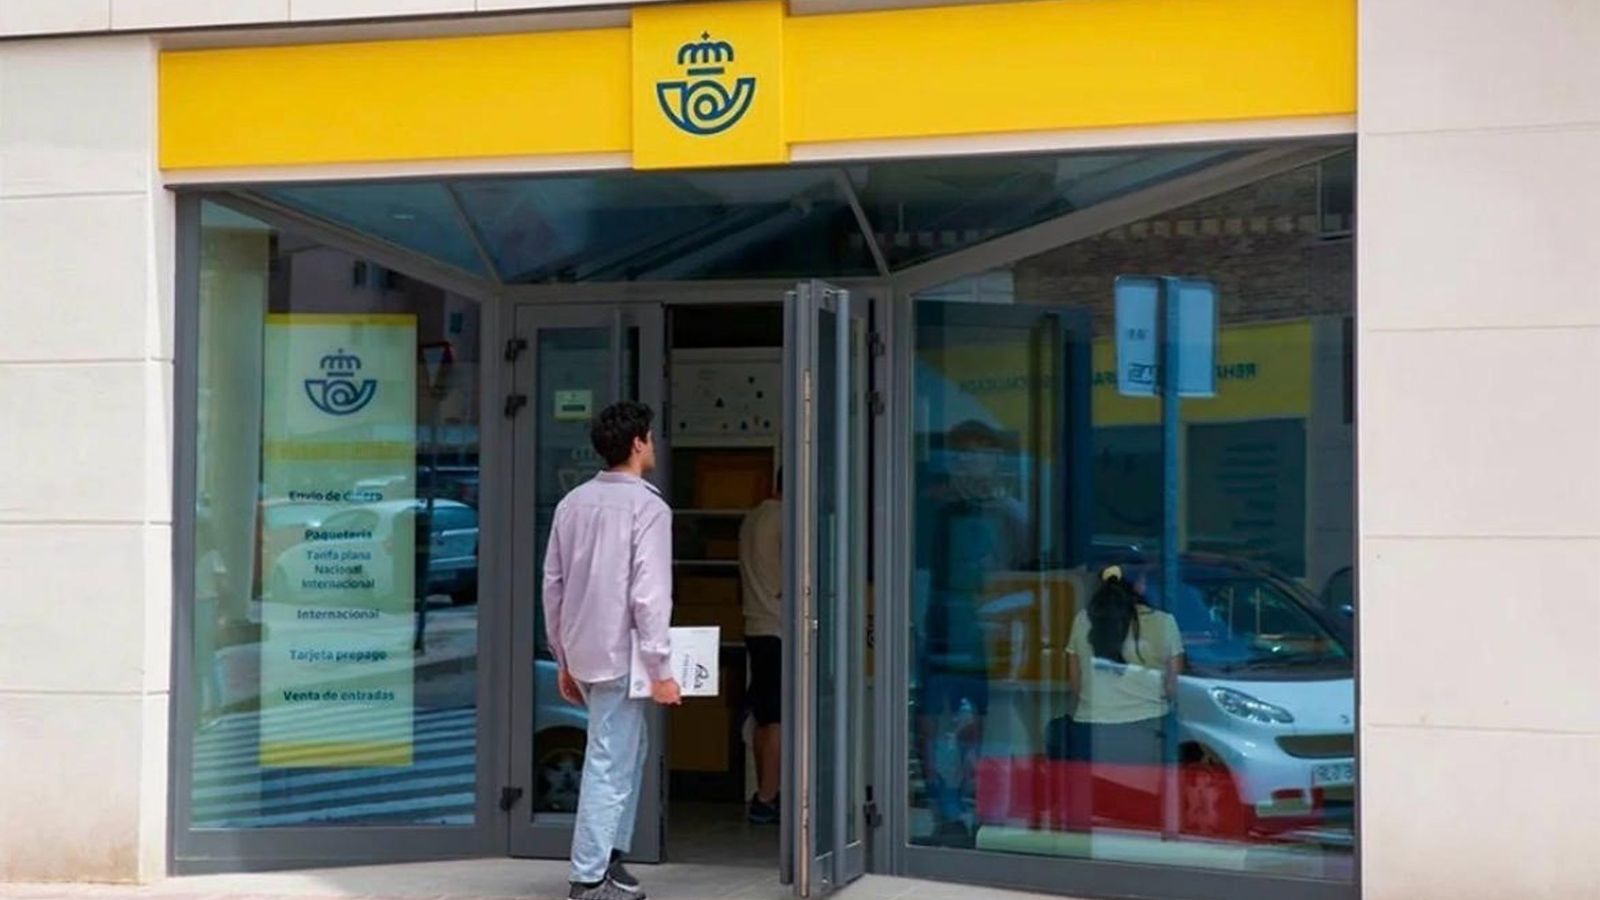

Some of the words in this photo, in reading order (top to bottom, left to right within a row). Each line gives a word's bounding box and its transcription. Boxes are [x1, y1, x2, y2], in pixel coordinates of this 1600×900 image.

[297, 608, 379, 619] Internacional
[283, 690, 320, 701] Venta
[322, 690, 338, 700] de
[341, 689, 395, 701] entradas
